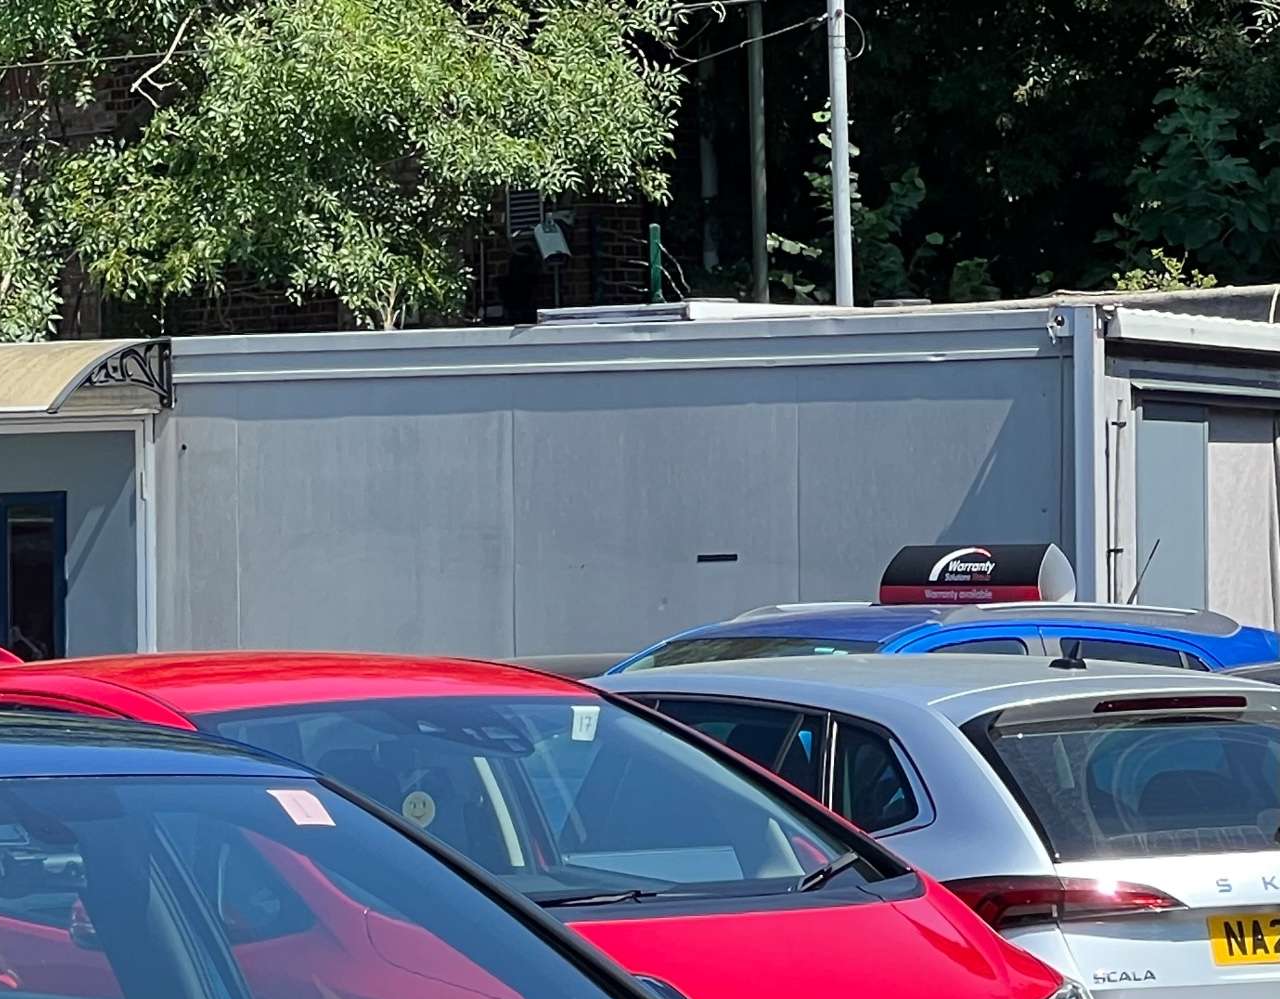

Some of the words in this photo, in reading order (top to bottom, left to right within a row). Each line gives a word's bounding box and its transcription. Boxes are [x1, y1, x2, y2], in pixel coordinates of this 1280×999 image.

[948, 560, 995, 574] Warranty
[924, 589, 958, 600] Warranty
[1093, 969, 1156, 984] SCALA
